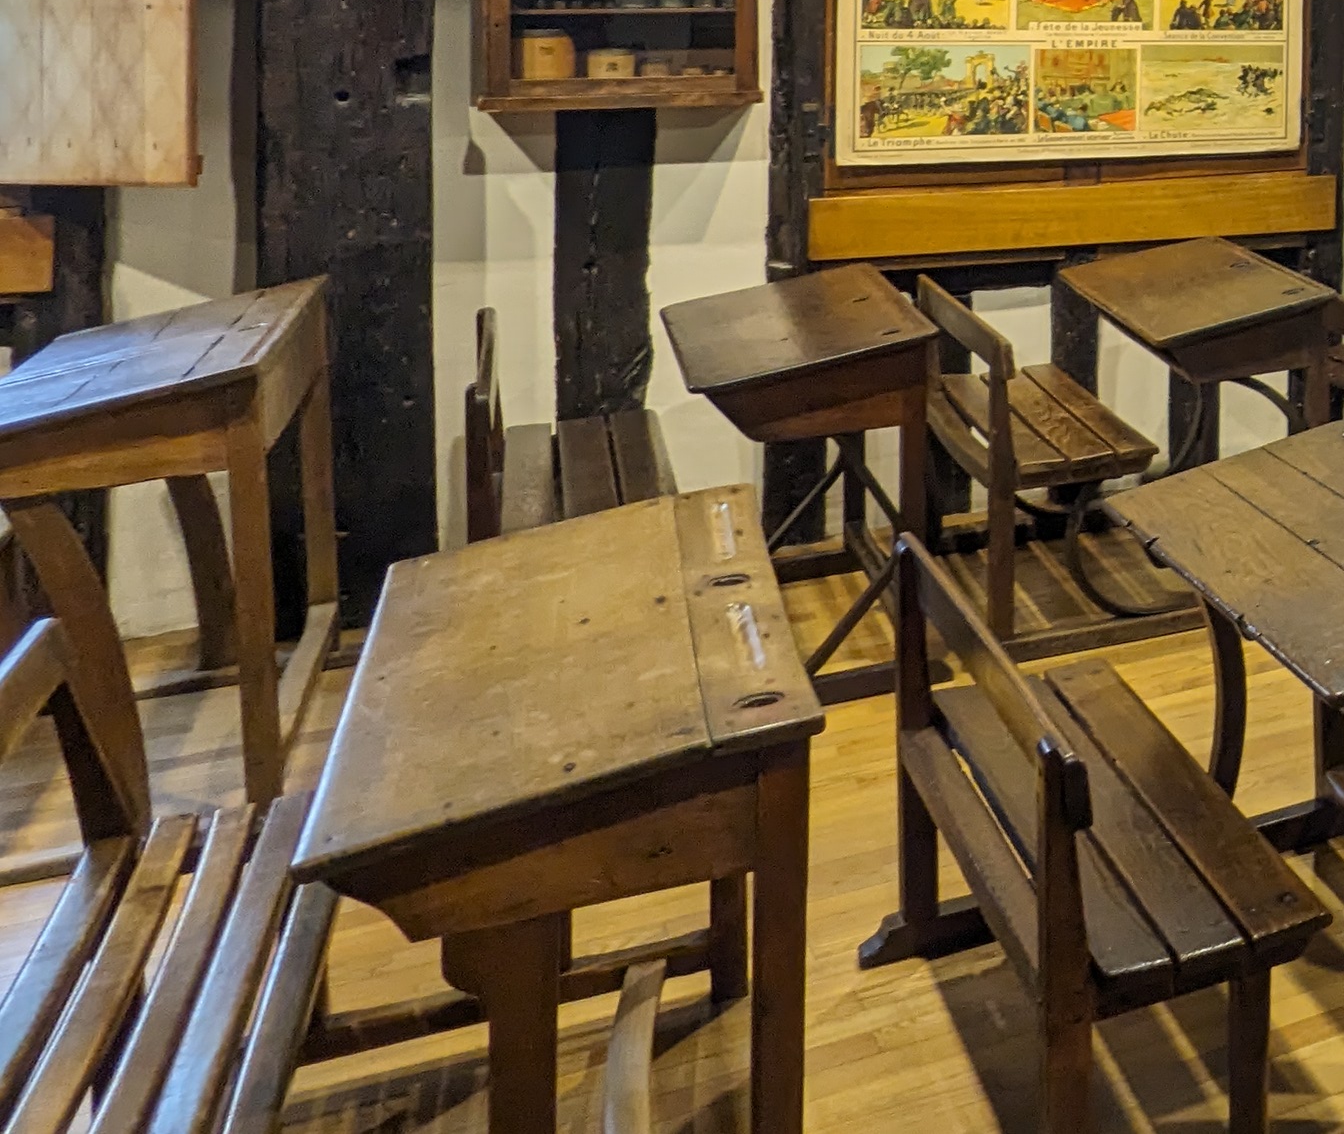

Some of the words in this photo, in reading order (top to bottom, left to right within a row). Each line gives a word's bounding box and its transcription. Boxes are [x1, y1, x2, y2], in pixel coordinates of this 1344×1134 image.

[868, 30, 889, 40] Nuit
[906, 30, 914, 38] 4
[866, 137, 879, 148] Le
[880, 136, 932, 148] Triomphe
